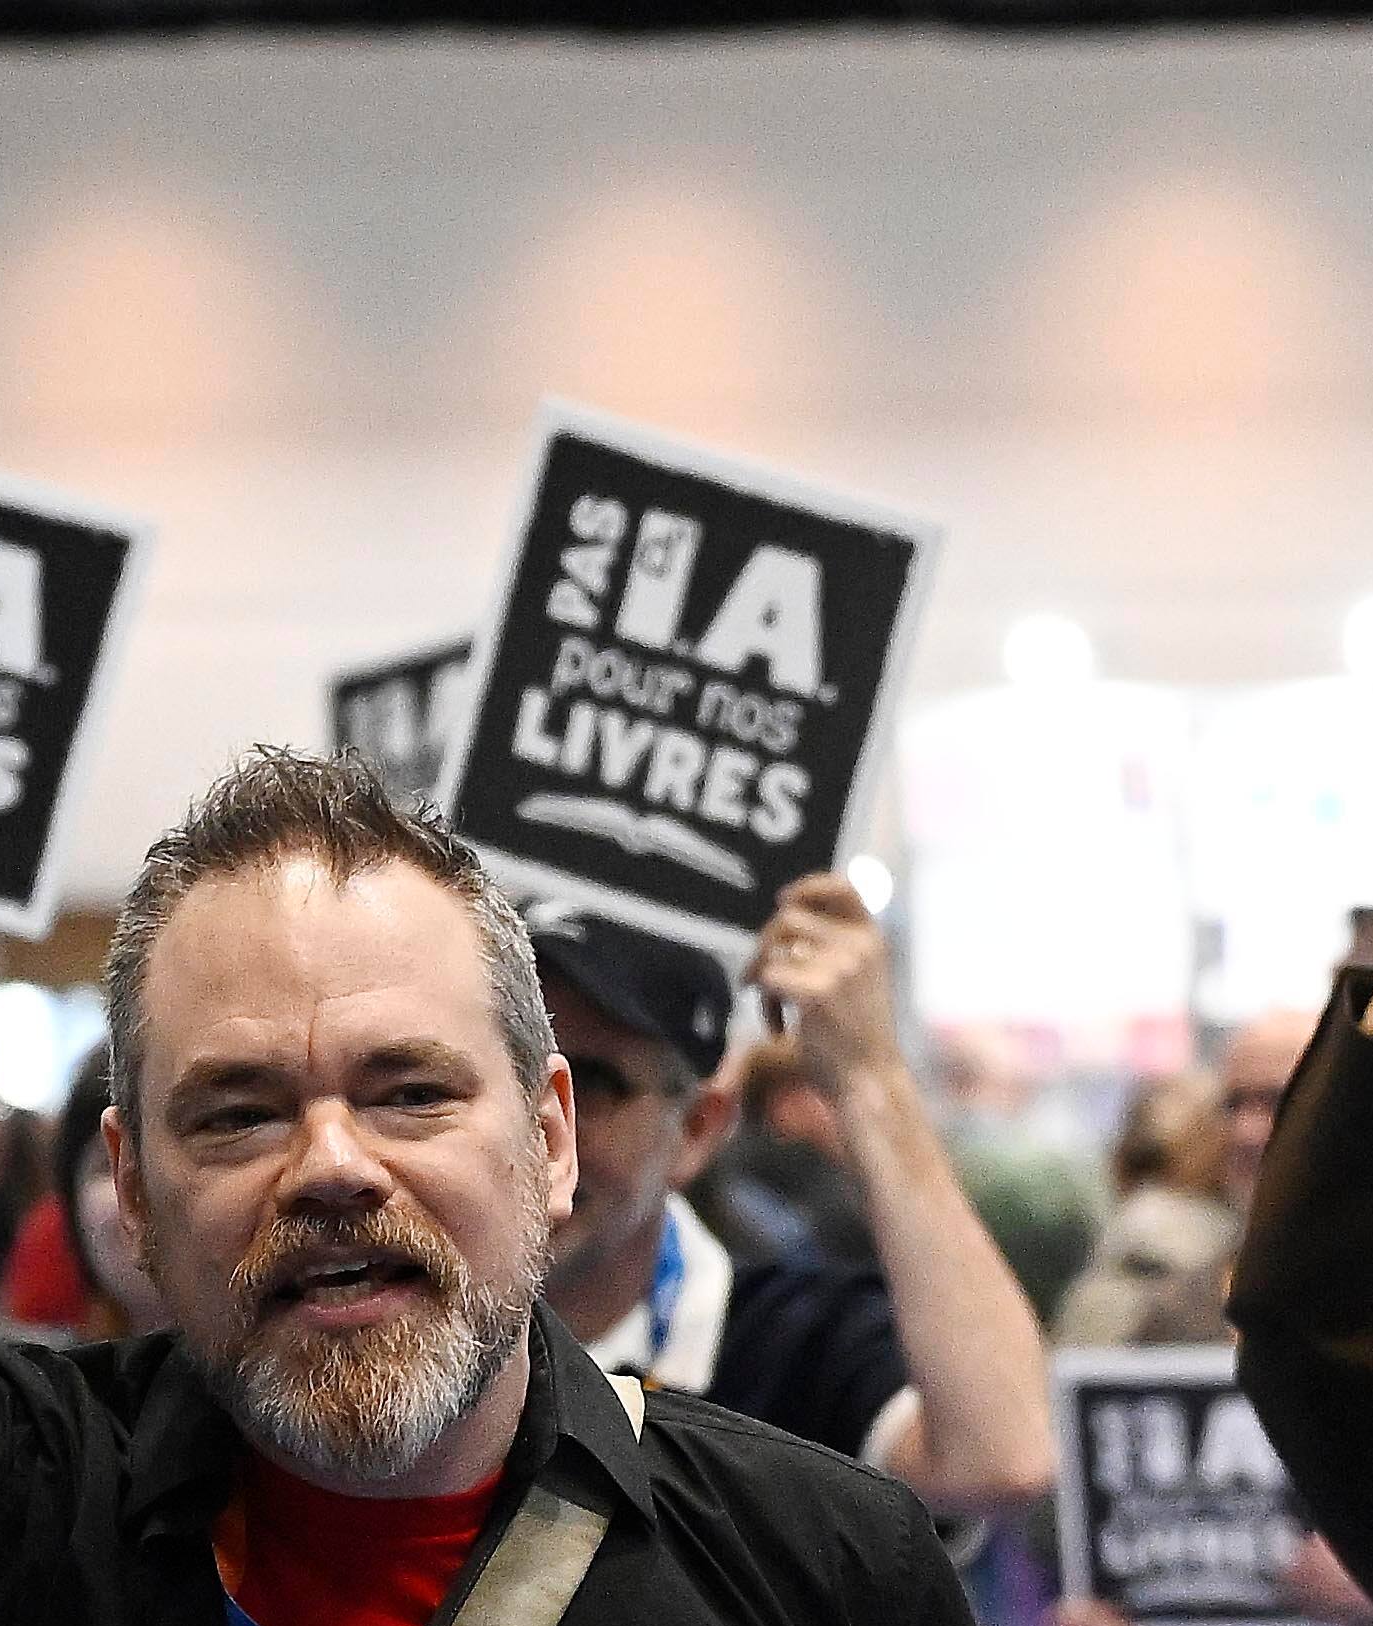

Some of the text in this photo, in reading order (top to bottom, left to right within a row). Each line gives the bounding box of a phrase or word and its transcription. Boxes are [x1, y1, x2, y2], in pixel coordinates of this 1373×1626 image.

[546, 496, 628, 629] PAS
[551, 635, 805, 752] pour nos
[512, 689, 812, 845] LIVRES
